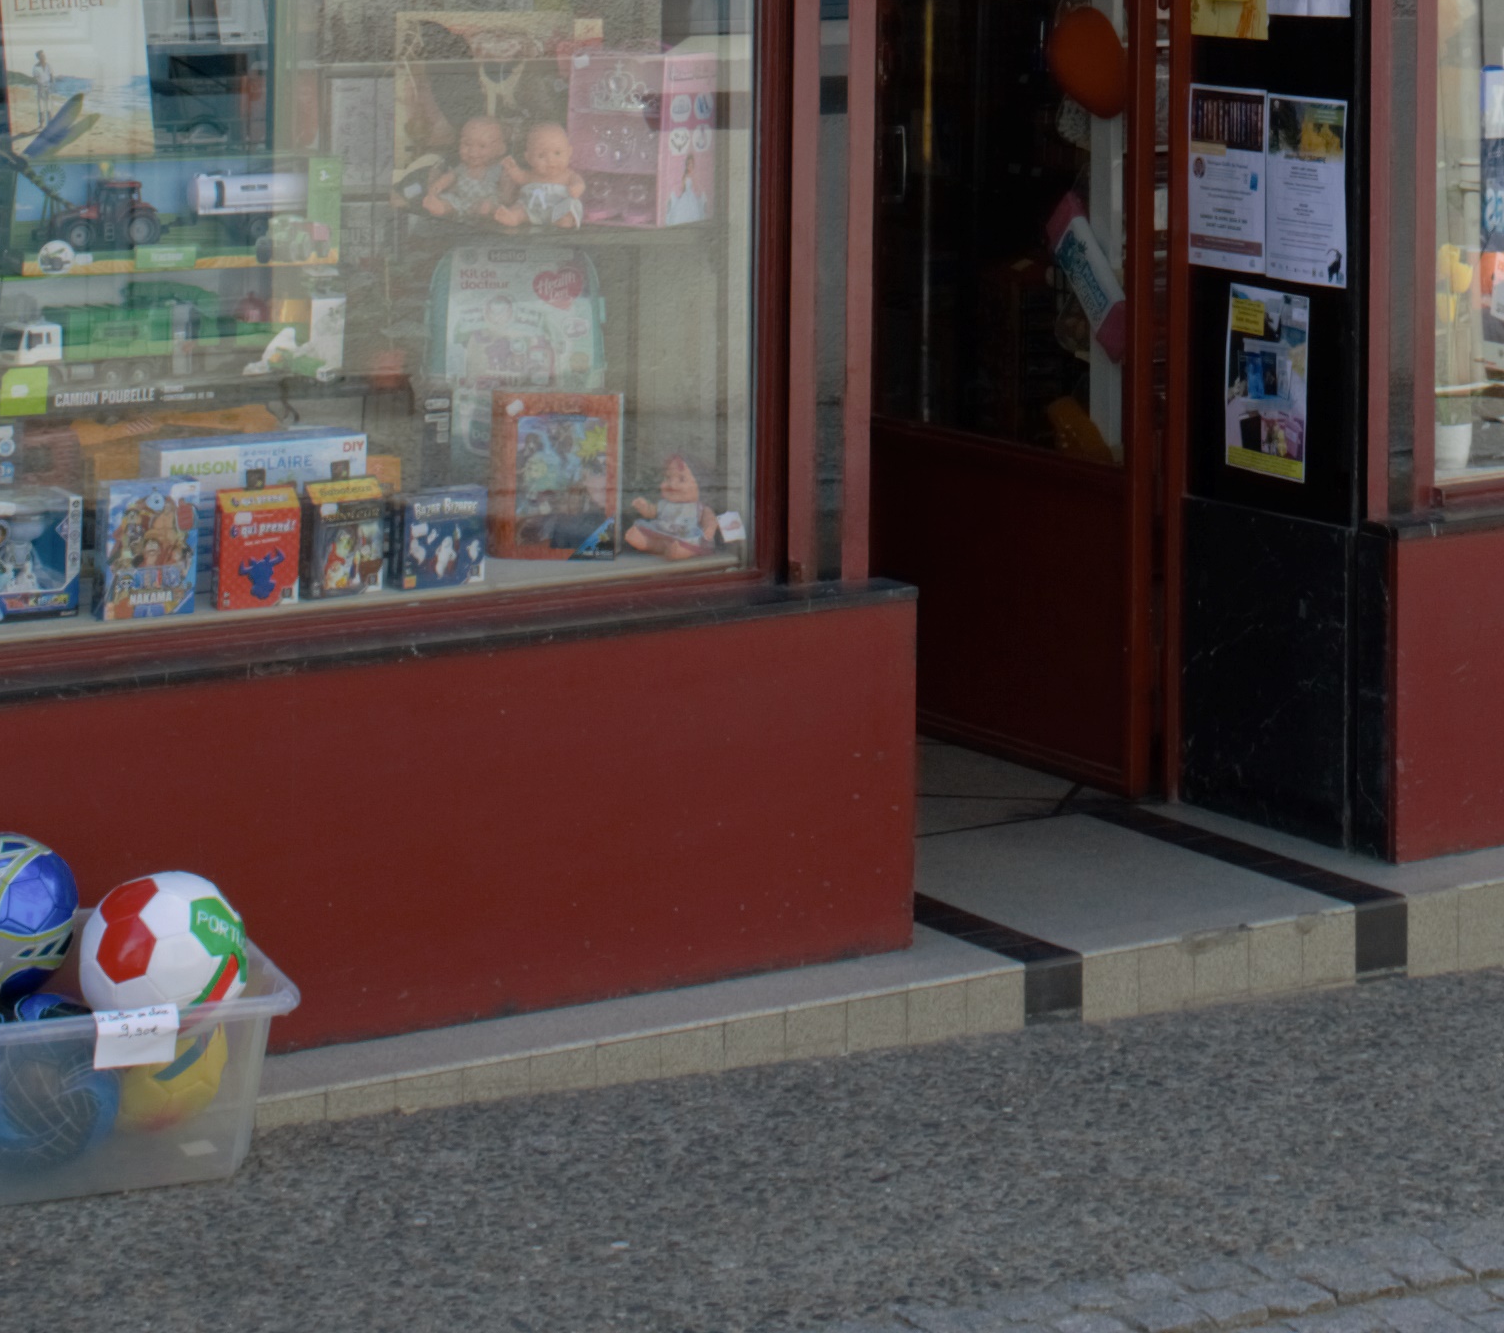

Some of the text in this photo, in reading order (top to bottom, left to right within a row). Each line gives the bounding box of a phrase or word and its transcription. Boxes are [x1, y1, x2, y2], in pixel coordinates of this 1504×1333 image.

[460, 269, 497, 279] Kit de
[460, 279, 511, 290] docteur
[54, 388, 156, 407] CAMION POUBELLE
[342, 440, 365, 453] DIY
[169, 454, 314, 477] MAISON SOLAIRE
[241, 522, 258, 537] qui
[260, 518, 297, 535] prend!
[129, 590, 173, 606] NAKAMA
